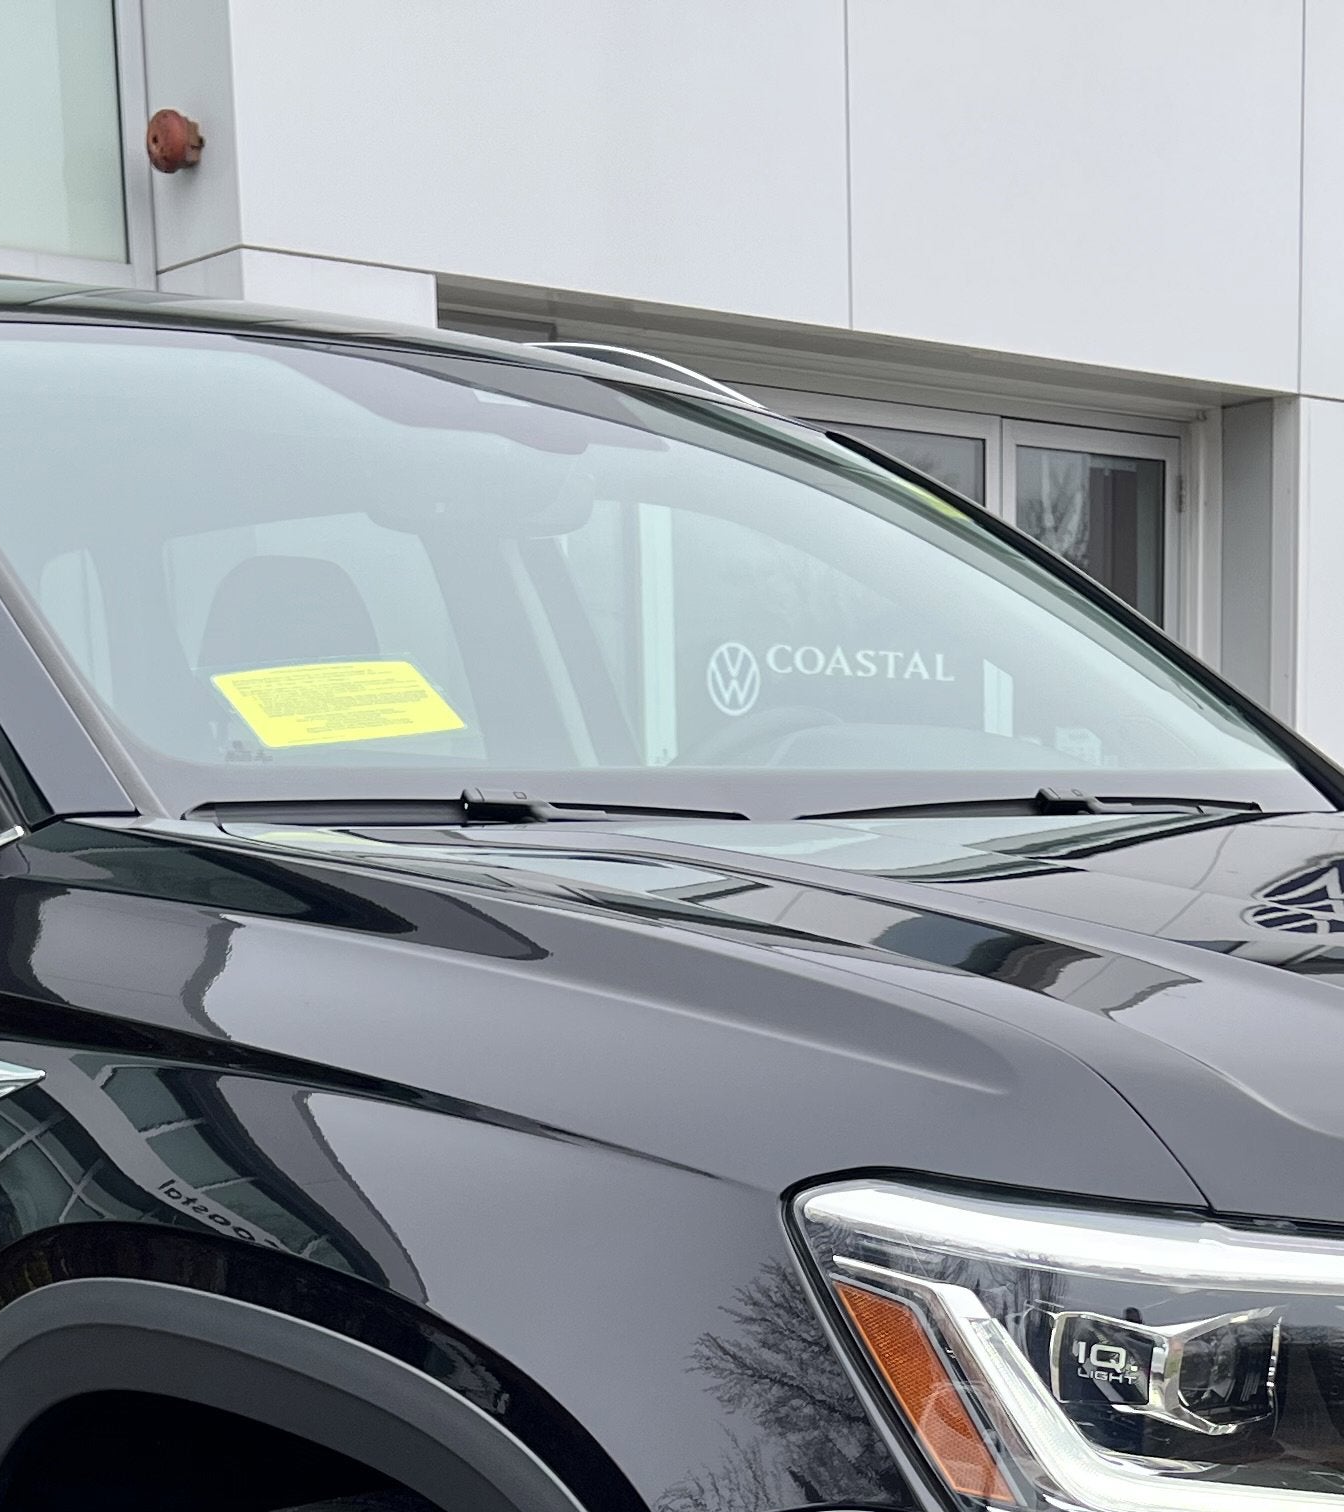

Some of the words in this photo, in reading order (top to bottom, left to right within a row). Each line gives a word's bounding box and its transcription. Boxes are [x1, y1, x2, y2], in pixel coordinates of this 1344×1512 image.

[707, 642, 760, 716] VW
[766, 644, 955, 682] COASTAL
[1077, 1367, 1137, 1385] LIGHT
